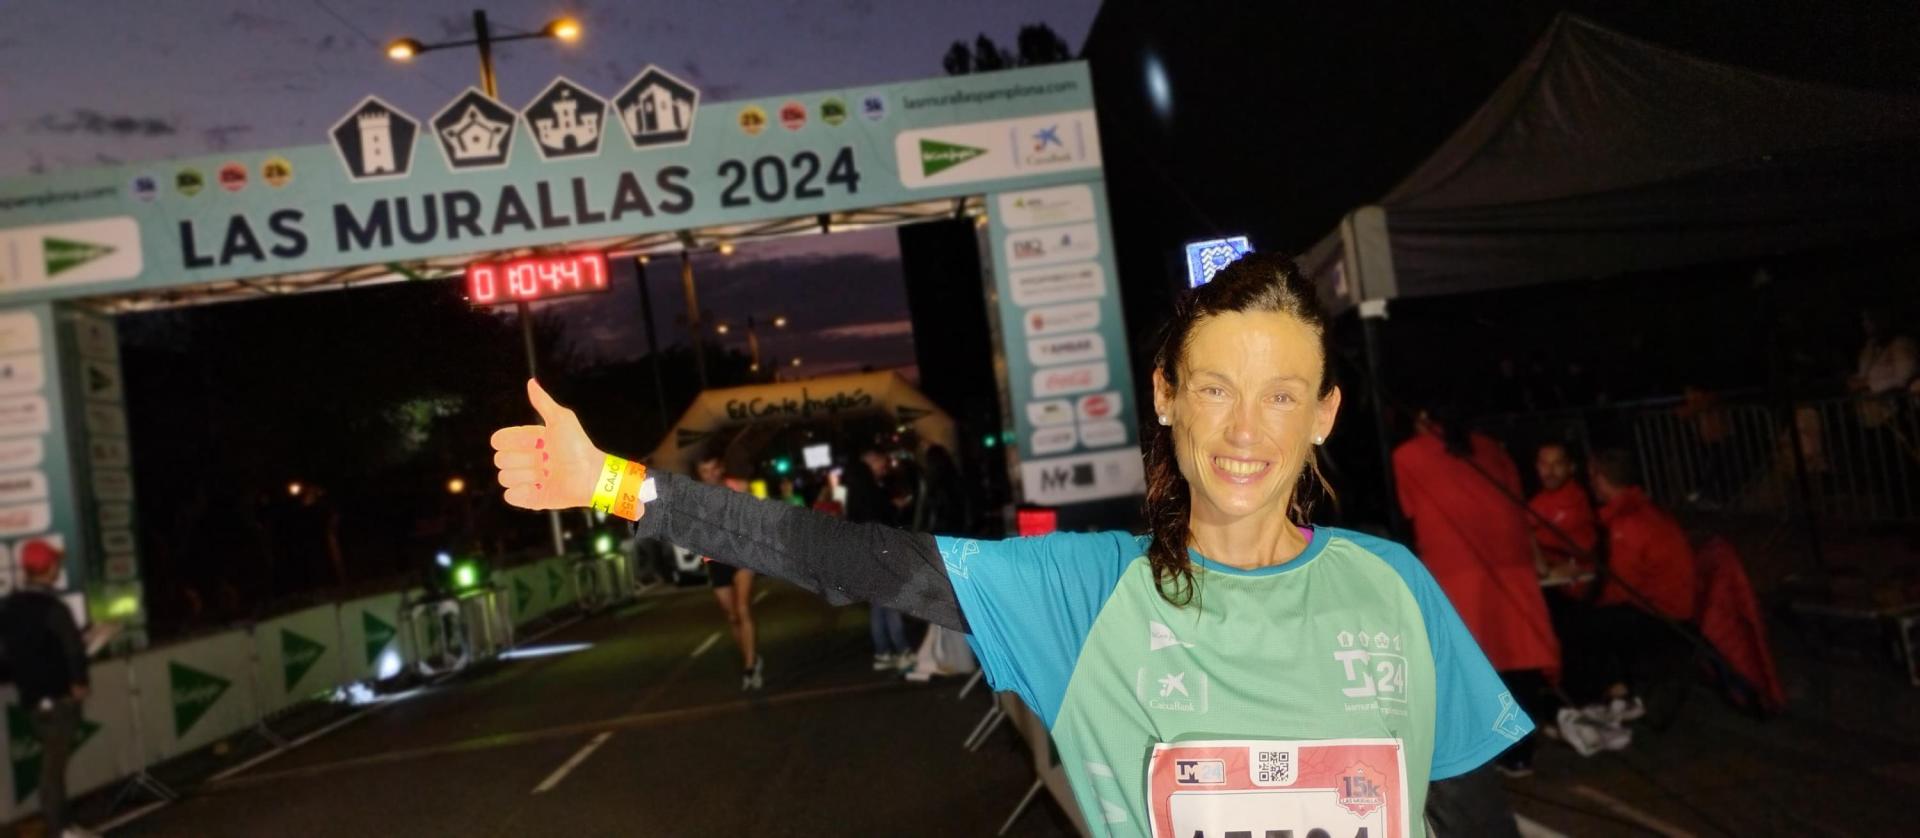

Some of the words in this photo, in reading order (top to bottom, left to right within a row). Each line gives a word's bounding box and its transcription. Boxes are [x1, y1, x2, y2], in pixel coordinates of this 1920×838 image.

[178, 209, 309, 269] LAS
[333, 165, 695, 253] MURALLAS
[716, 146, 861, 208] 2024
[725, 398, 747, 419] El
[749, 396, 799, 417] Corte
[604, 458, 621, 494] CAJÓ
[1376, 661, 1404, 694] 24
[1343, 775, 1382, 798] 15k
